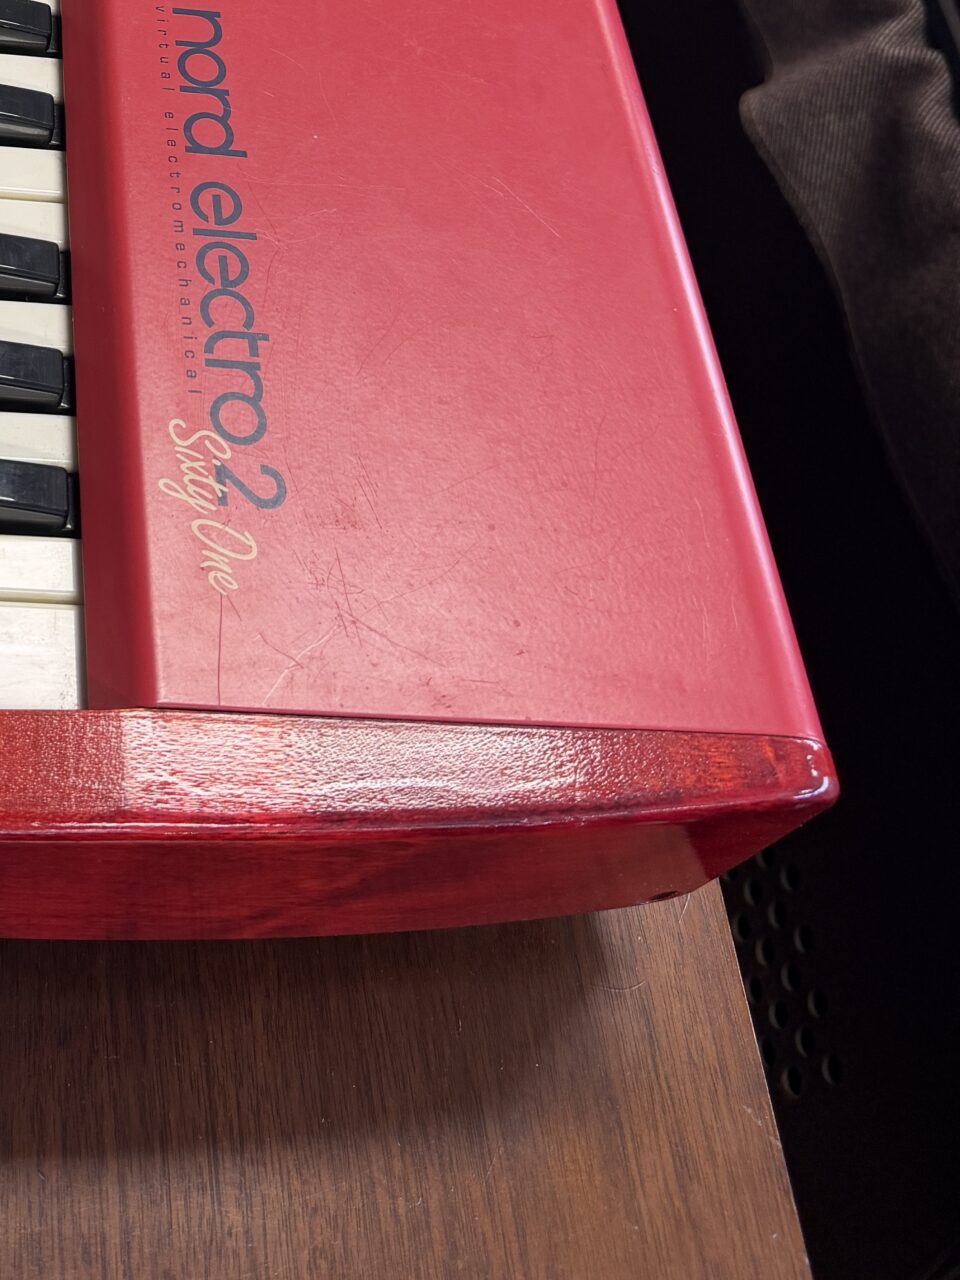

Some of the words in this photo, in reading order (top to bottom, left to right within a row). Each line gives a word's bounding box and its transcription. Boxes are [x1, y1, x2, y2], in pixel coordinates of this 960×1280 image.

[156, 5, 174, 92] virtual
[172, 8, 248, 159] nord
[164, 111, 202, 395] electromechanical
[190, 181, 270, 446] electro
[158, 418, 231, 515] Sixty
[215, 464, 288, 511] 2
[190, 518, 258, 594] One
